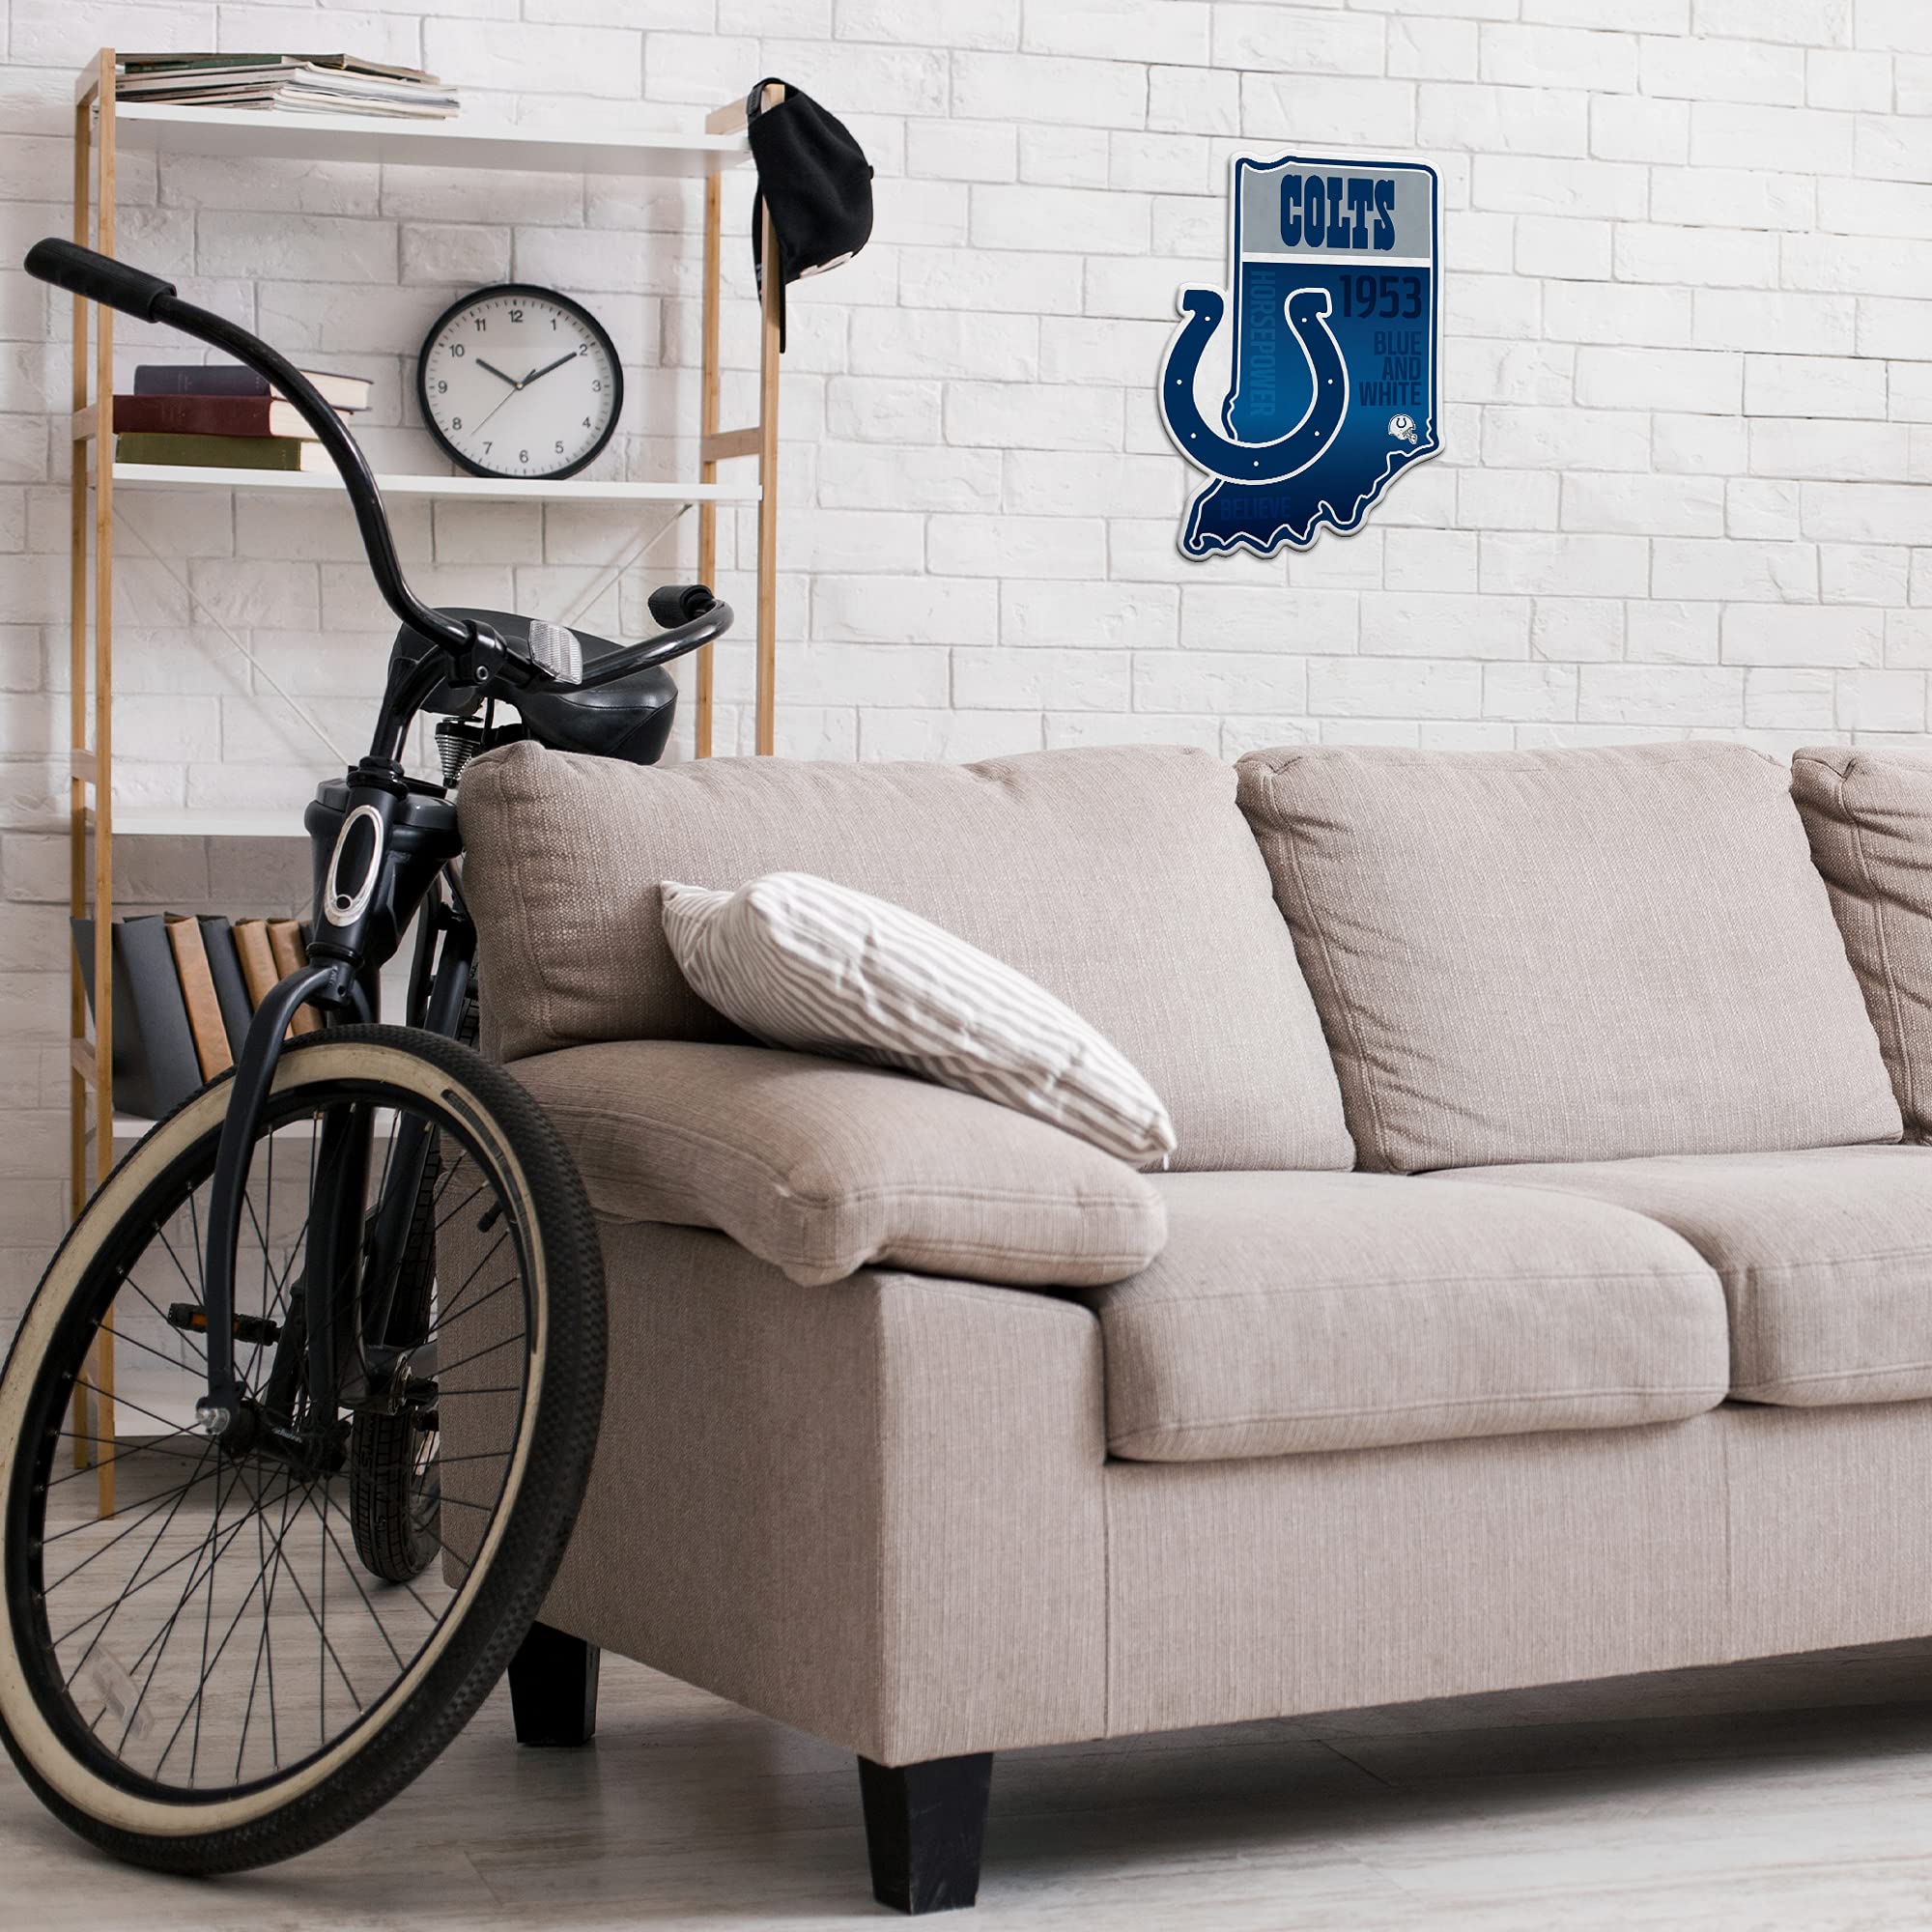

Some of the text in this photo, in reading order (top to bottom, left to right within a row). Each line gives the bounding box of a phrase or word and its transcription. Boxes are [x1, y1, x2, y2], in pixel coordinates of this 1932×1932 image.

[1280, 174, 1395, 251] COLTS
[1339, 273, 1422, 319] 1953
[508, 309, 524, 323] 12
[474, 319, 486, 331] 11
[551, 319, 556, 330] 1
[580, 344, 588, 356] 2
[1250, 270, 1276, 417] HORSEPOWER
[1374, 330, 1422, 356] BLUE
[449, 344, 465, 357] 10
[1381, 356, 1422, 382] AND
[438, 381, 448, 394] 9
[592, 380, 602, 392] 3
[1359, 381, 1422, 407] WHITE
[452, 417, 462, 430] 8
[582, 417, 591, 428] 4
[483, 441, 493, 455] 7
[554, 440, 564, 454] 5
[519, 450, 529, 464] 6
[1220, 497, 1292, 522] BELIEVE
